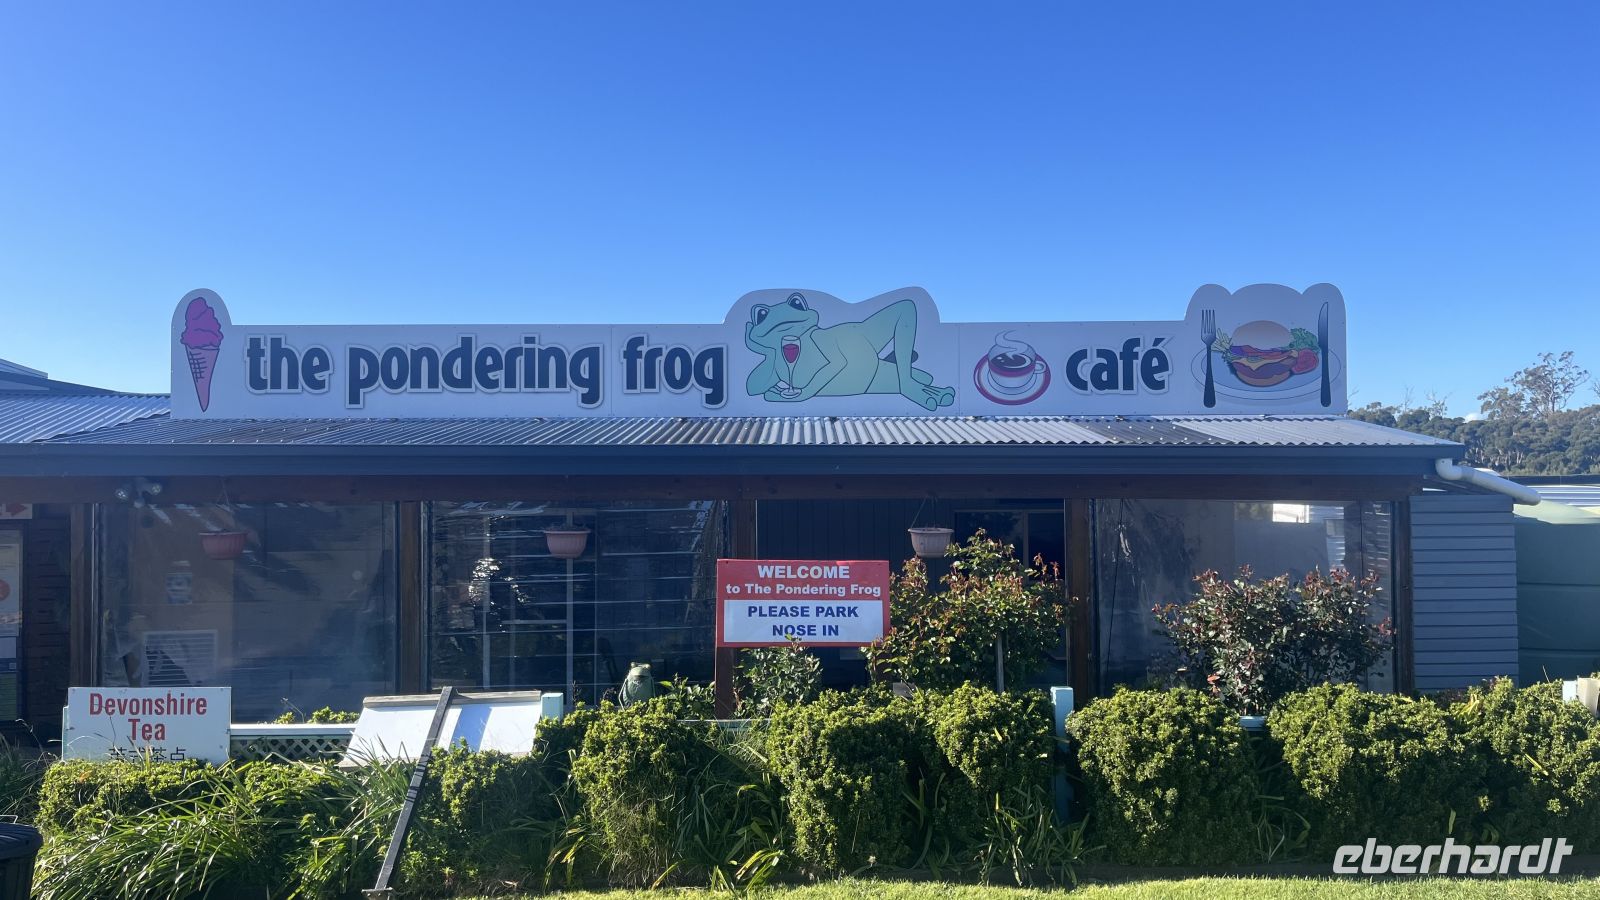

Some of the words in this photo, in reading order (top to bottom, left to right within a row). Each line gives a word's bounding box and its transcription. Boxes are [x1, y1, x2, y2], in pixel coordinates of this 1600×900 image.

[246, 336, 331, 391] the
[347, 335, 601, 406] pondering
[622, 335, 725, 406] frog
[1065, 336, 1170, 391] café
[757, 564, 850, 579] WELCOME
[726, 583, 740, 594] to
[745, 583, 772, 594] The
[776, 583, 846, 597] Pondering
[850, 583, 881, 597] Frog
[747, 605, 810, 618] PLEASE
[815, 605, 859, 618] PARK
[772, 624, 817, 637] NOSE
[822, 624, 839, 637] IN
[89, 692, 208, 716] Devonshire
[127, 718, 166, 741] Tea
